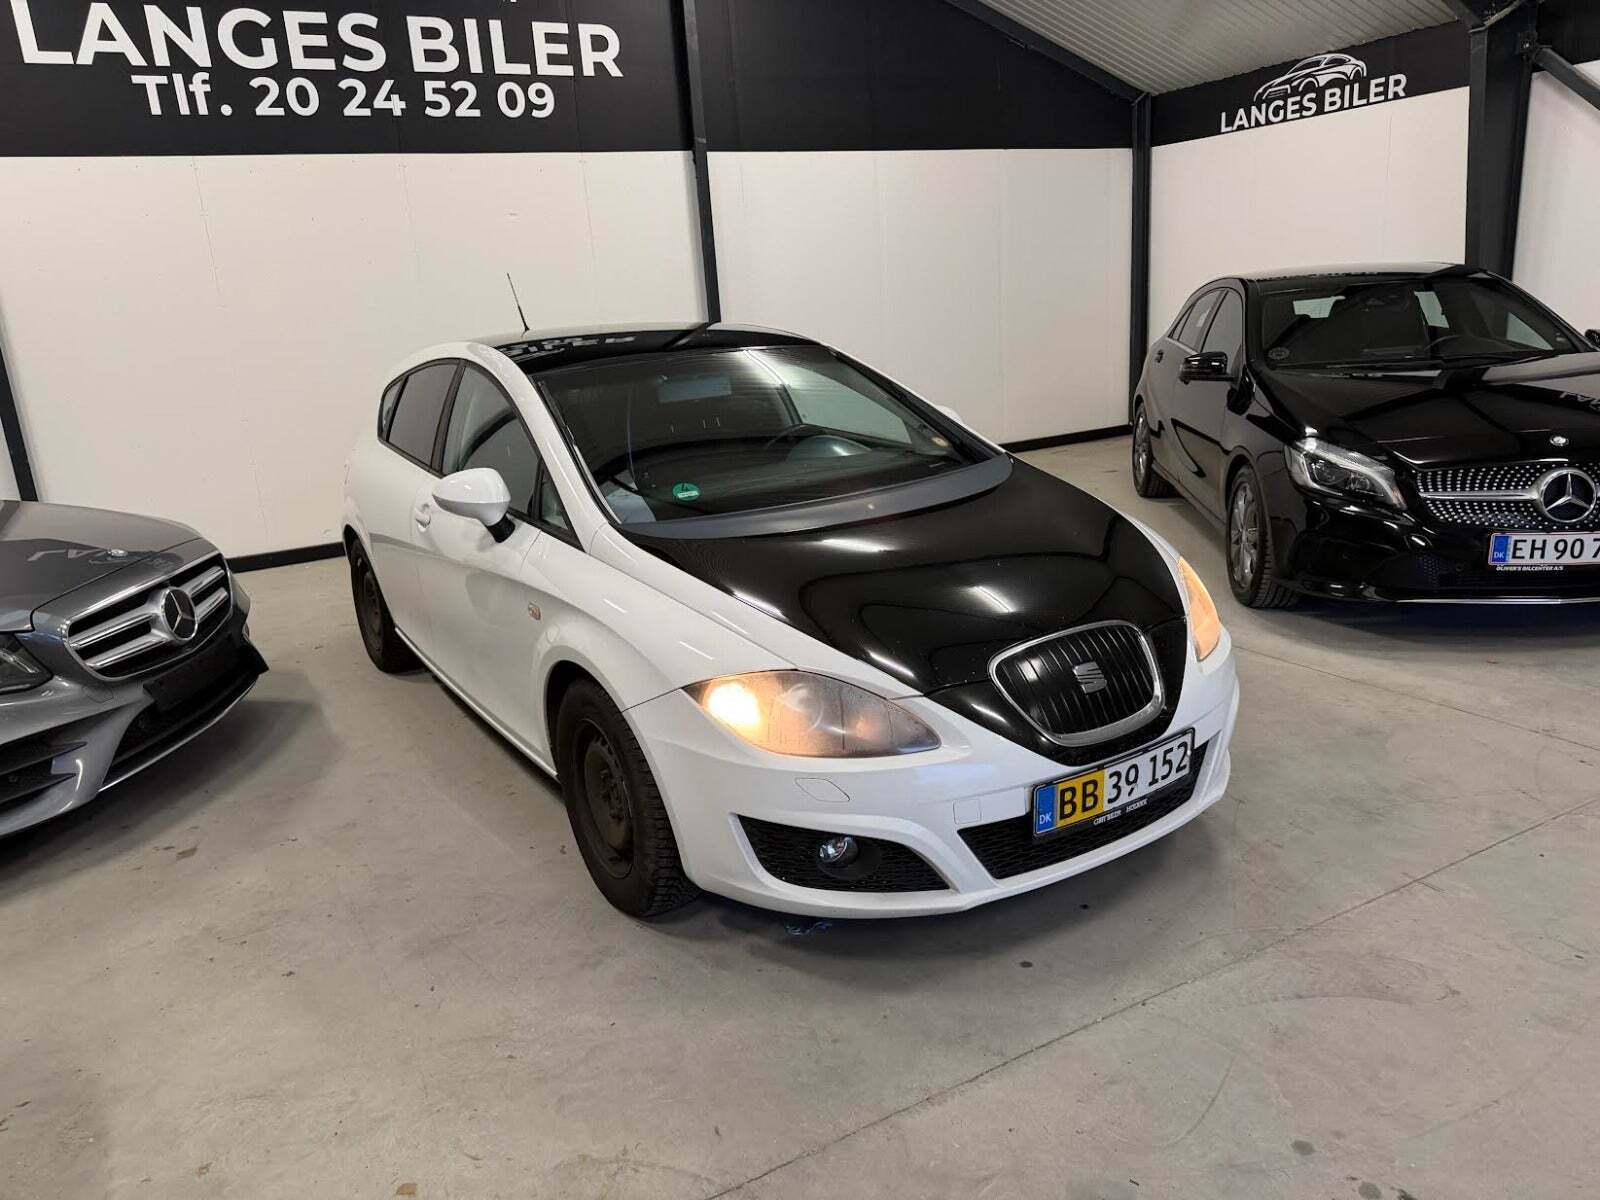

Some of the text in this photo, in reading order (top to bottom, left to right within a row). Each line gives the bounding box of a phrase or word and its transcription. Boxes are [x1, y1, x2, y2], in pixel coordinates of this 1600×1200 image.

[10, 0, 625, 77] LANGES BILER
[130, 71, 556, 119] Tlf. 20 24 52 09
[1219, 73, 1408, 133] LANGES BILER
[1493, 551, 1505, 559] DK
[1511, 539, 1547, 560] EH
[1553, 538, 1585, 560] 90
[1059, 778, 1099, 820] BB
[1107, 763, 1140, 804] 39
[1148, 741, 1189, 787] 152
[1039, 811, 1052, 824] DK
